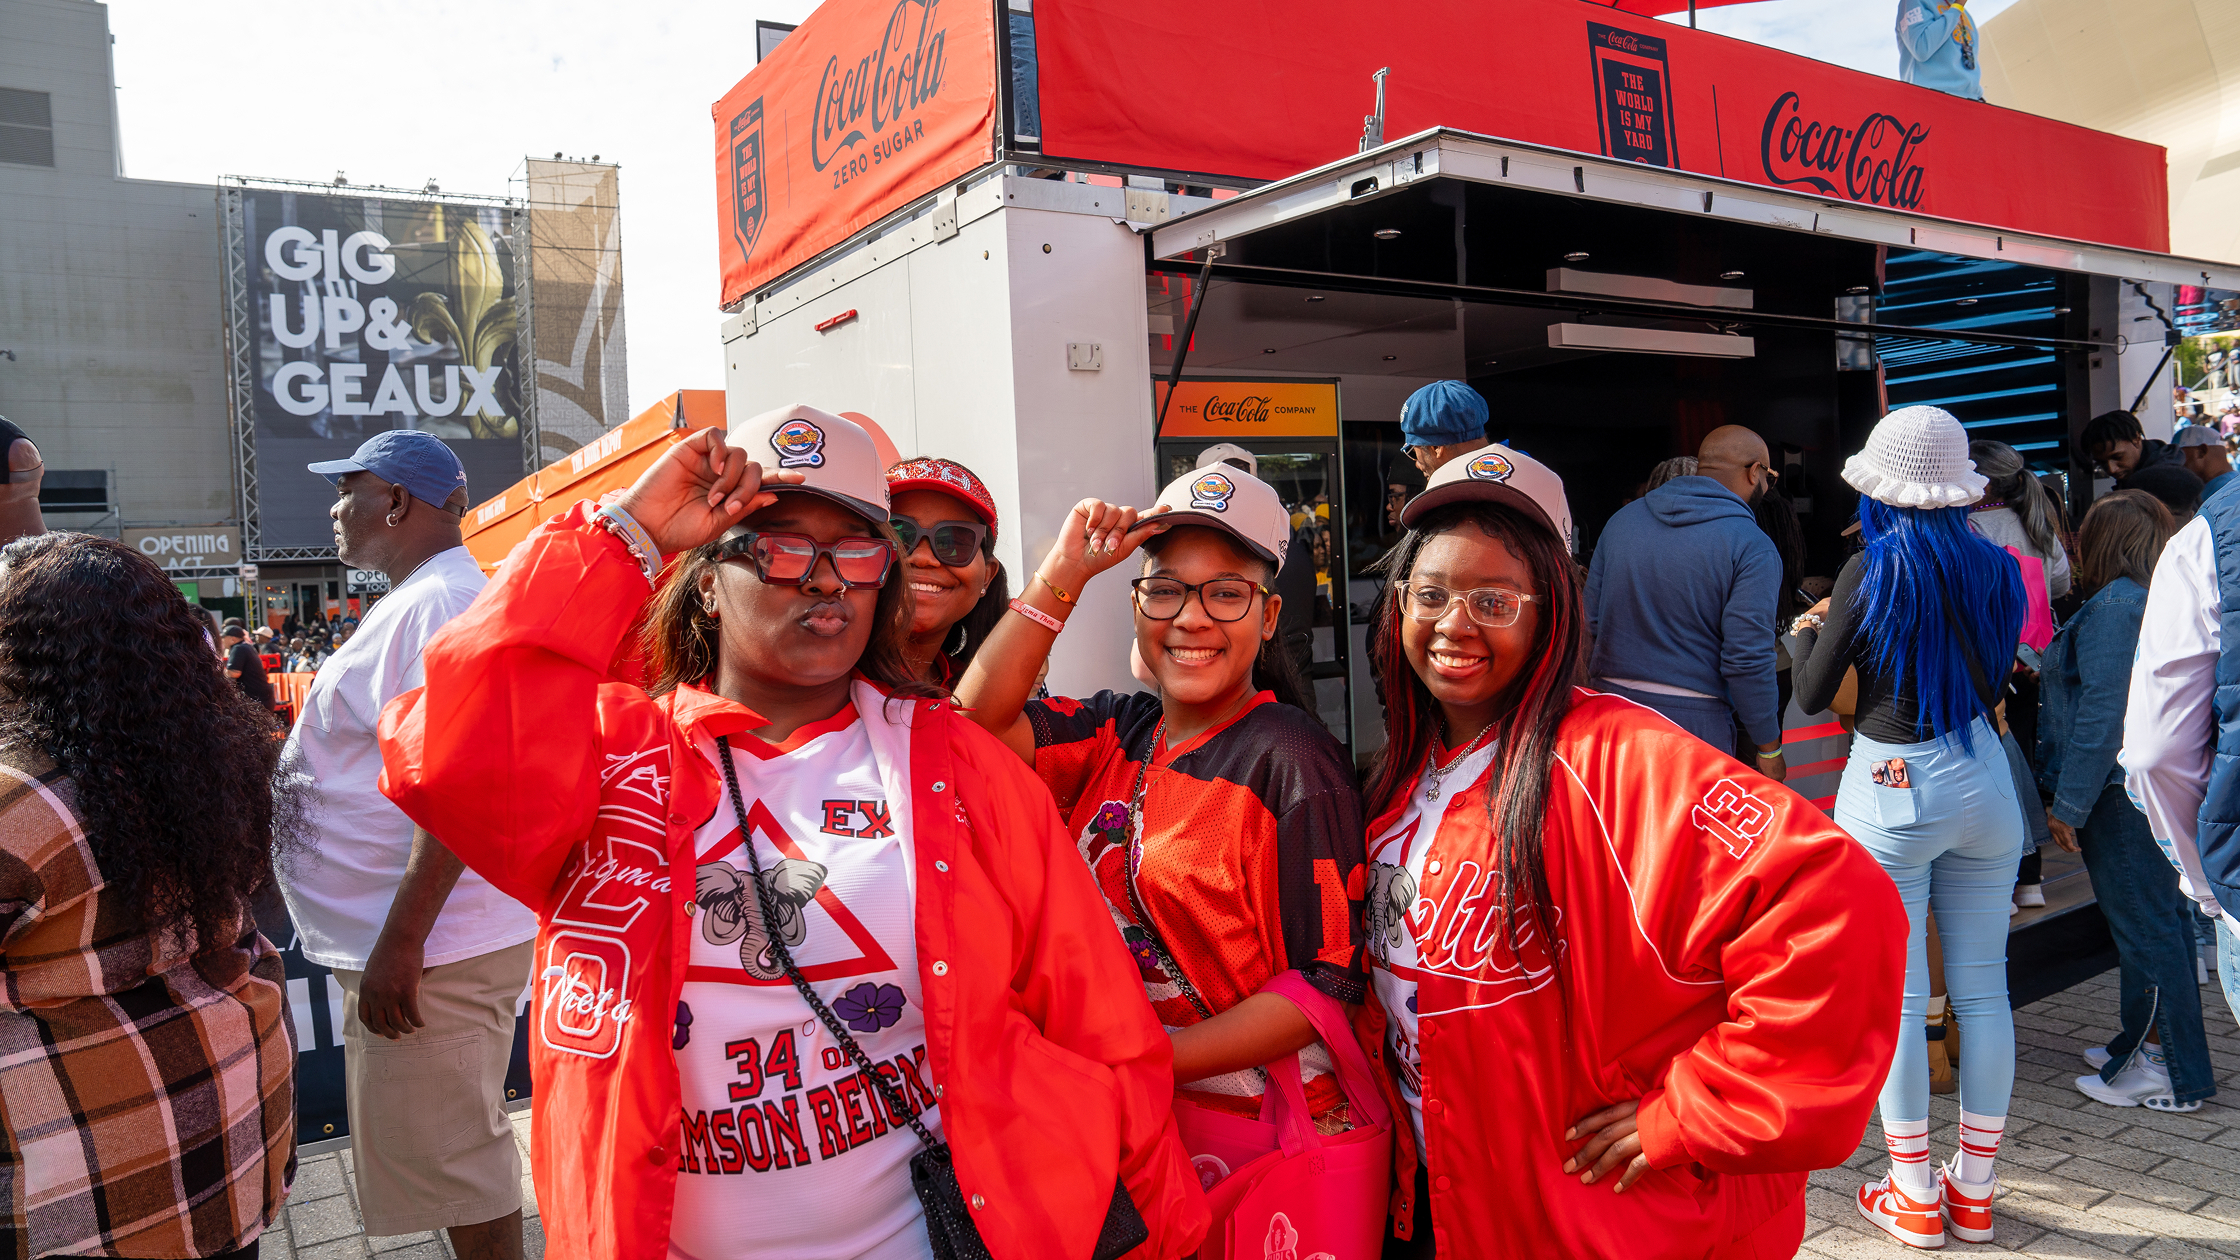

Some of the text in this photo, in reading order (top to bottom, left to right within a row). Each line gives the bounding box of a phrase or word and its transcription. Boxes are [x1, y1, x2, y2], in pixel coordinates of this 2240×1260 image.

[1615, 89, 1654, 113] WORLD
[1621, 71, 1644, 92] THE
[1620, 109, 1652, 131] IS MY
[1624, 130, 1653, 151] YARD
[833, 118, 925, 190] ZERO SUGAR
[1761, 91, 1931, 210] Coca-Cola
[264, 225, 396, 285] GIG
[269, 293, 414, 351] UP&
[272, 360, 507, 417] GEAUX
[1179, 395, 1316, 422] THE Coca-Cola COMPANY
[139, 534, 230, 556] OPENING
[168, 556, 204, 568] ACT
[366, 581, 389, 592] FOO
[1691, 778, 1775, 860] 13
[541, 965, 634, 1023] Theta
[725, 1028, 803, 1103] 34
[680, 1044, 938, 1175] MSON REIGN
